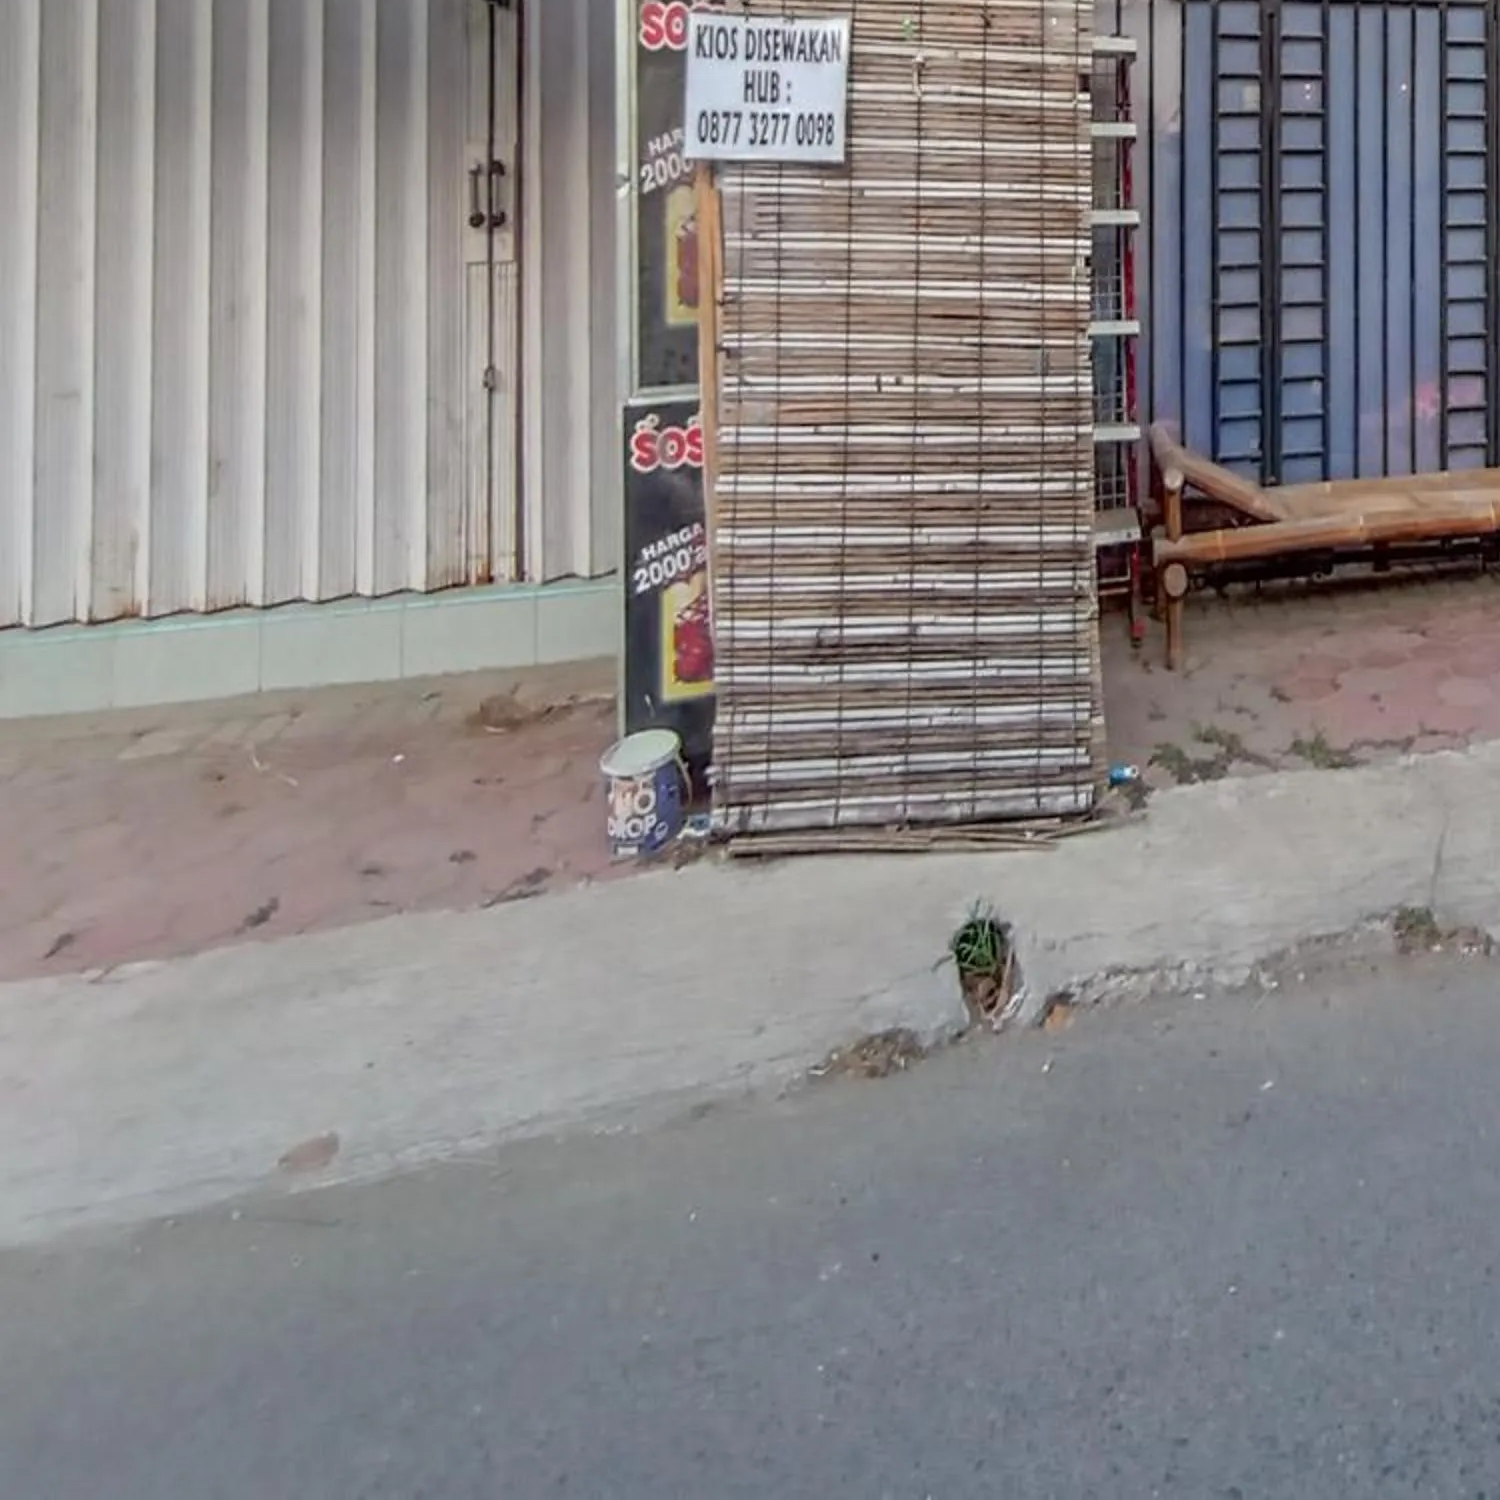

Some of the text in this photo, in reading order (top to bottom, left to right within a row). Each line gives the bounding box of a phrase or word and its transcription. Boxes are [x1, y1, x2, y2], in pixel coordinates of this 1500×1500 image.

[695, 24, 842, 63] KIOS DISEWAKAN
[744, 69, 780, 104] HUB
[697, 110, 835, 146] 0877 3277 0098
[641, 522, 703, 561] HARGA
